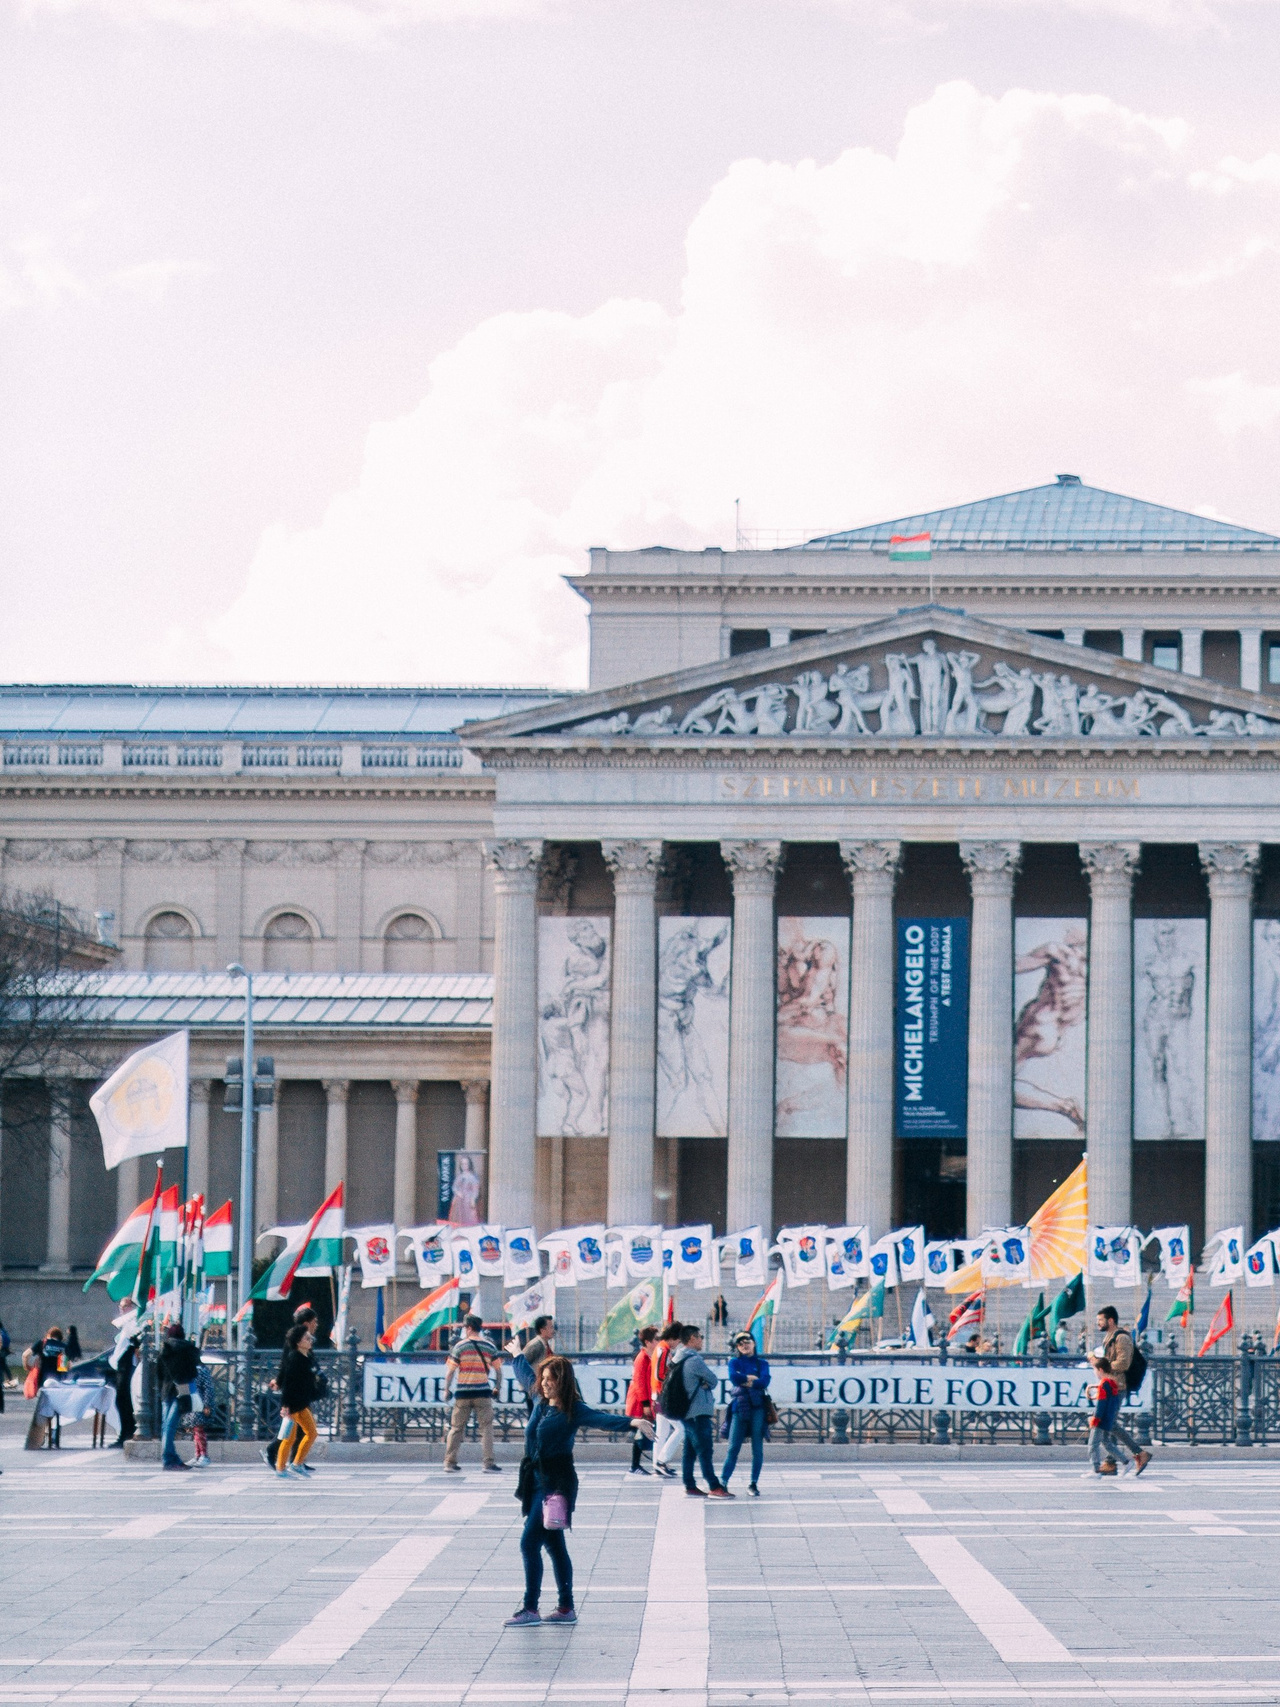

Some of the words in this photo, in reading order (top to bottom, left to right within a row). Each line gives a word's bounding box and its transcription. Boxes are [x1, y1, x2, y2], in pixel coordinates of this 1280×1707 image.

[930, 926, 939, 954] BODY
[941, 926, 951, 970] DIADALA
[930, 957, 939, 975] THE
[930, 978, 939, 994] OF
[941, 972, 951, 997] TEST
[904, 925, 925, 1101] MICHELANGELO
[941, 998, 951, 1007] A
[929, 997, 939, 1042] TRIUMPH
[794, 1377, 933, 1406] PEOPLE
[946, 1379, 1019, 1407] FOR
[1030, 1380, 1144, 1408] PEAE
